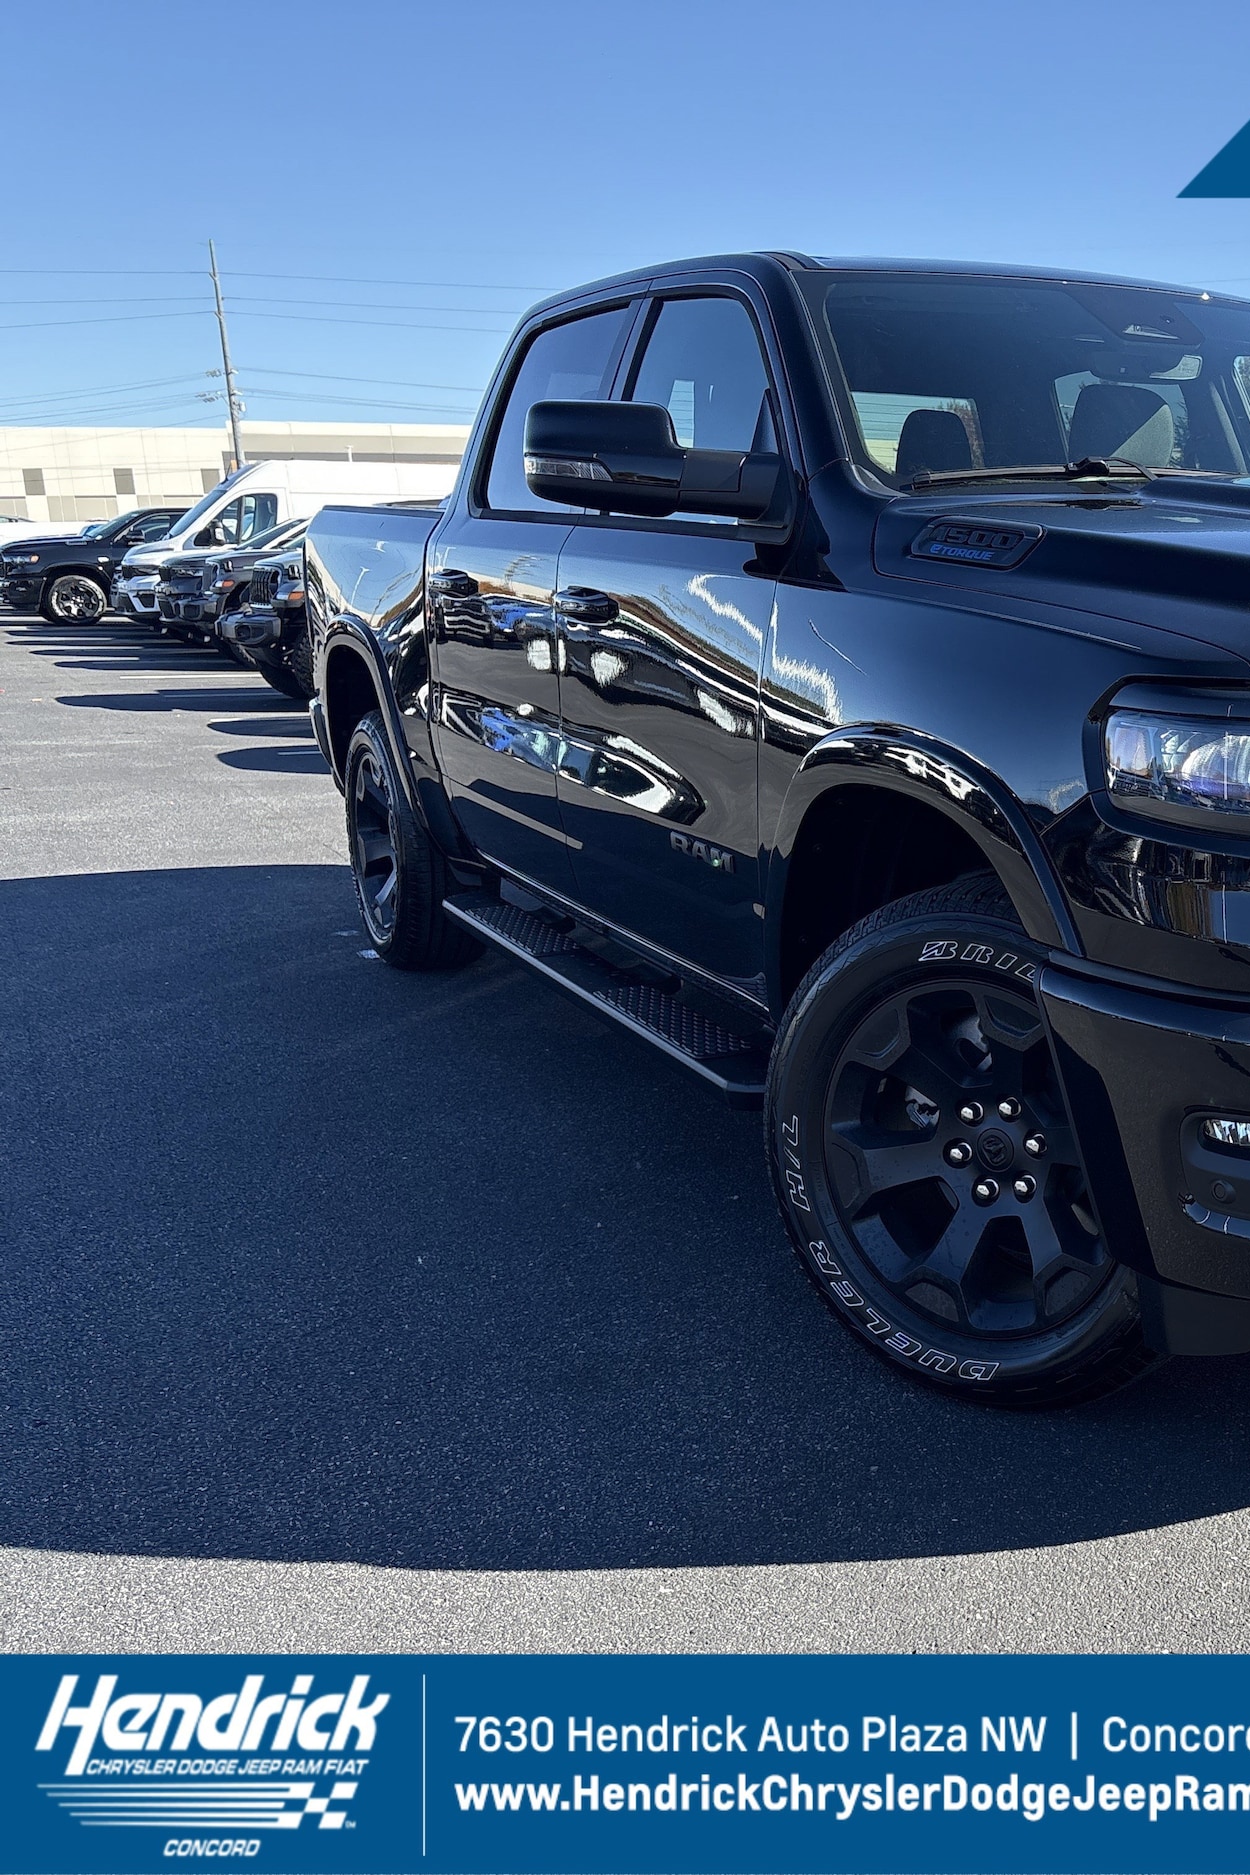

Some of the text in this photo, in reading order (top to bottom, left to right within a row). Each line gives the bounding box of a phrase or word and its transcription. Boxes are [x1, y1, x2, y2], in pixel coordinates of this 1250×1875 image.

[932, 526, 1022, 550] 1500
[670, 831, 734, 873] RAM
[809, 1240, 1001, 1381] DUELER
